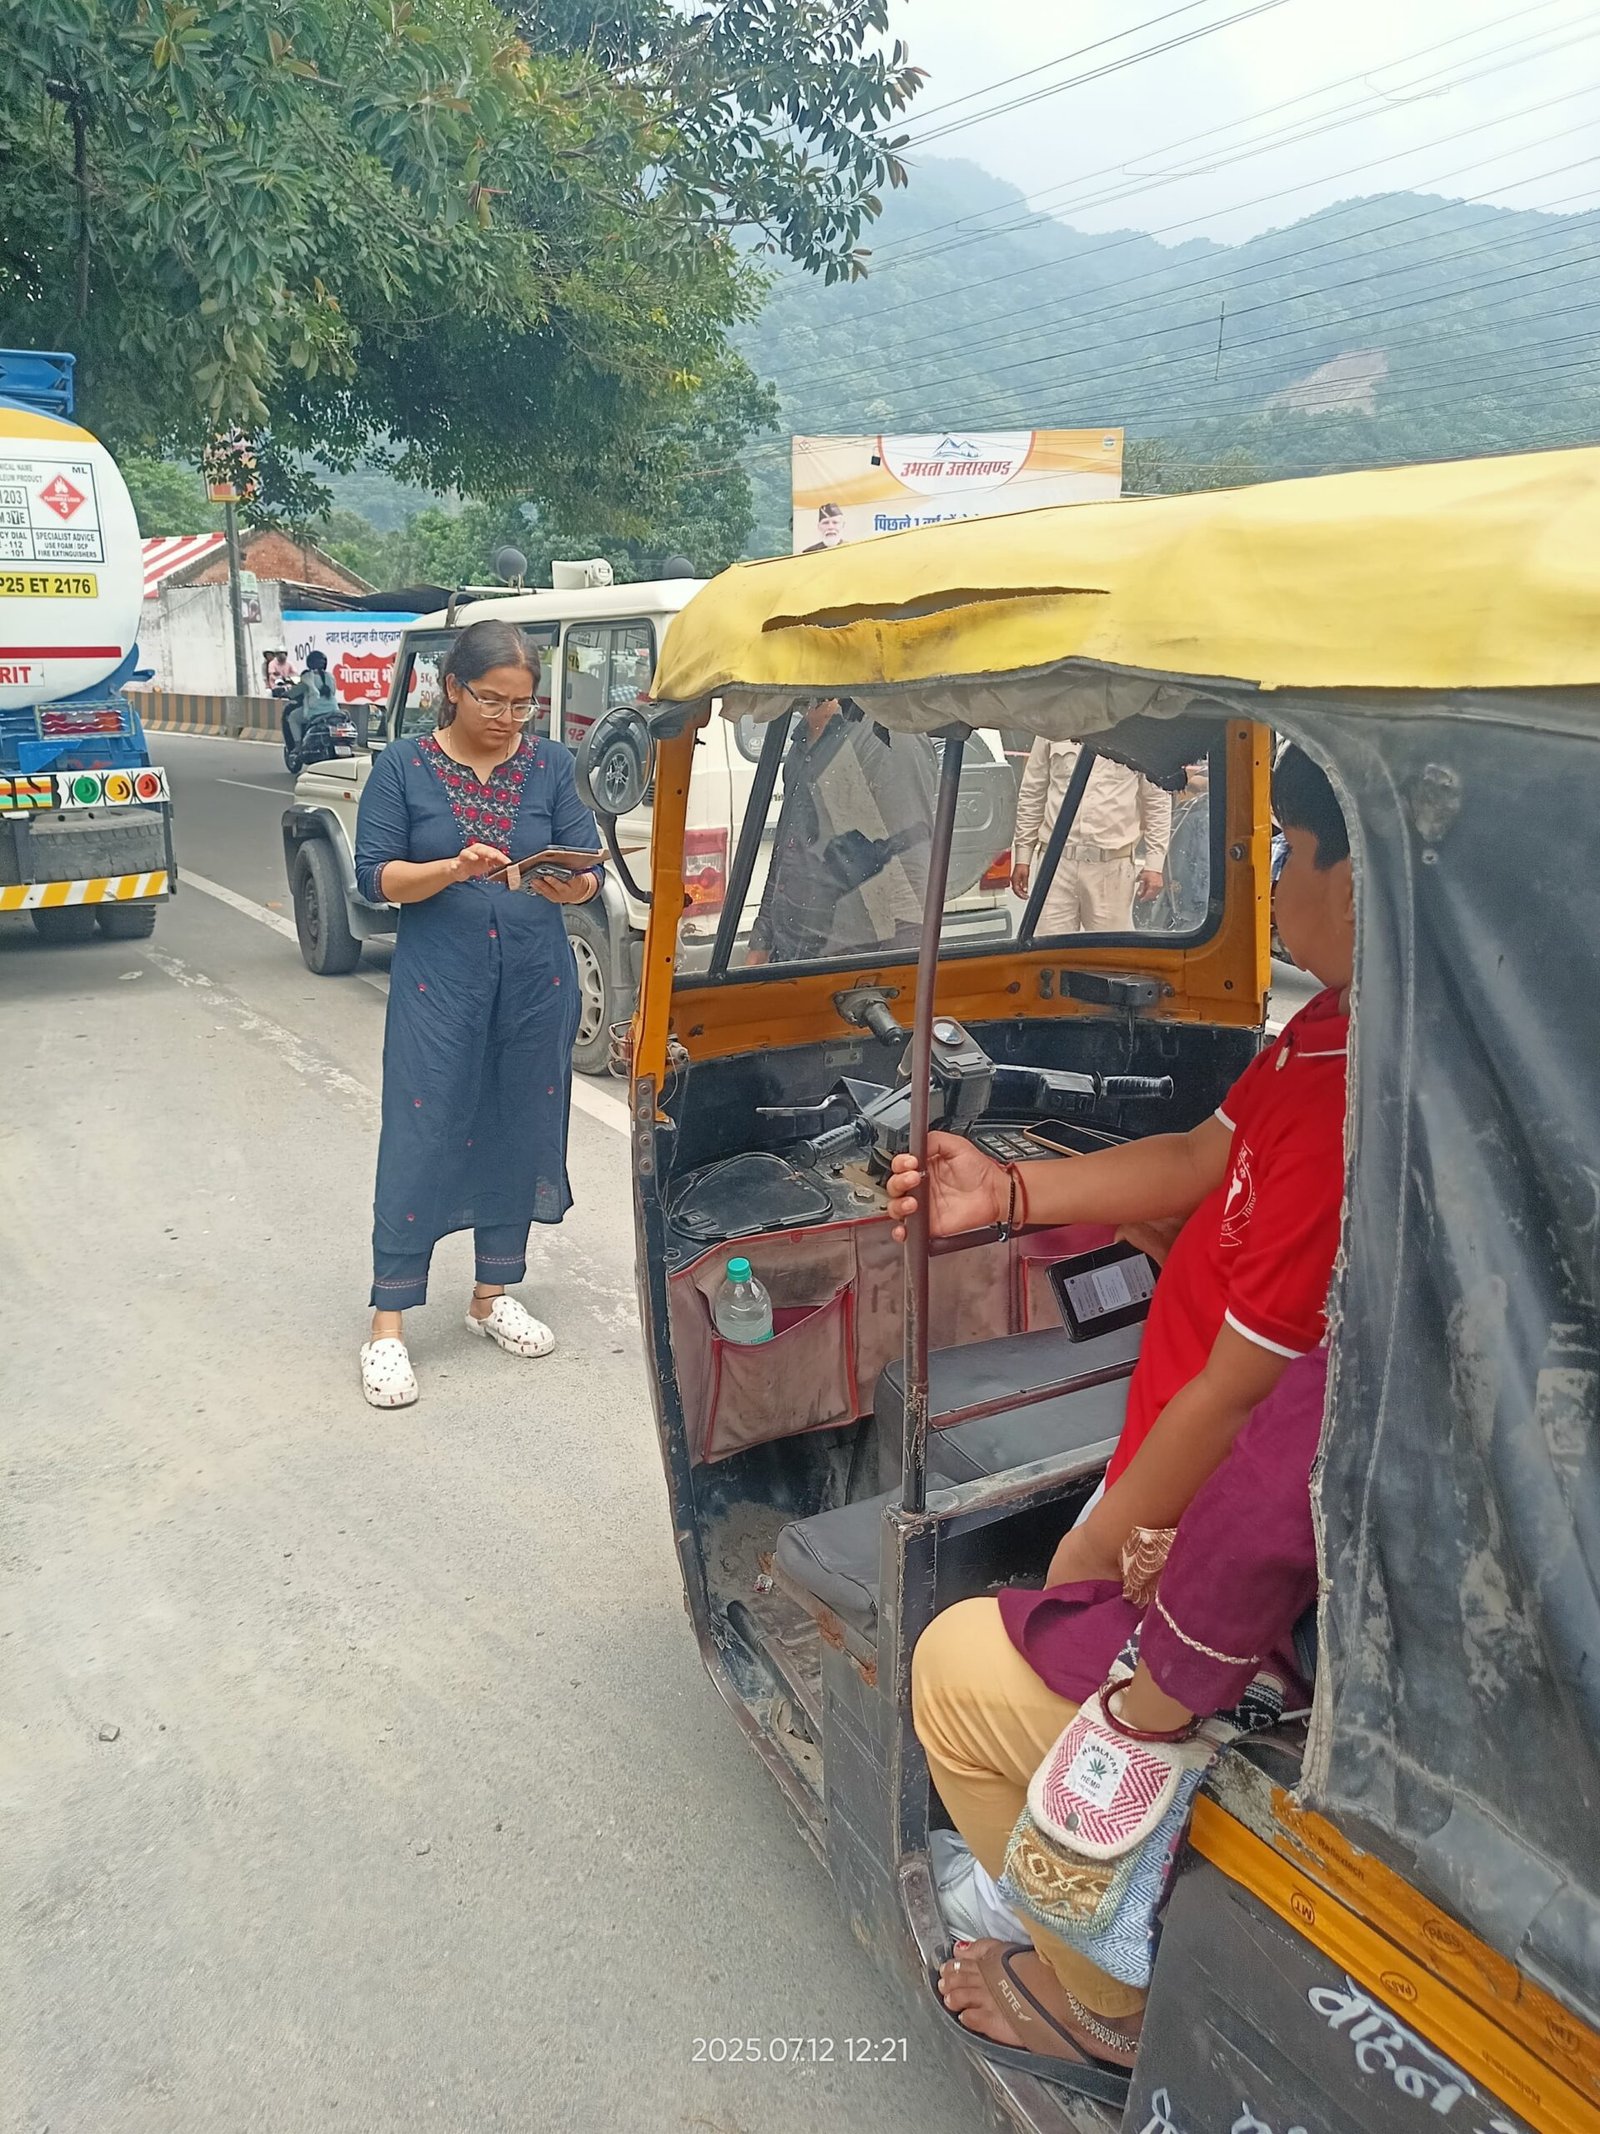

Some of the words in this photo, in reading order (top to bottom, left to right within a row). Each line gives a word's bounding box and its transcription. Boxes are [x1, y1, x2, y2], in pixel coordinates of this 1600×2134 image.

[900, 462, 944, 477] उभरता
[945, 460, 1013, 476] उत्तराखण्ड
[60, 503, 69, 513] 3
[874, 514, 911, 531] पिछले
[36, 532, 71, 541] SPECIALIST
[73, 533, 95, 542] ADVICE
[52, 550, 97, 558] EXTINGUISHERS
[29, 577, 49, 593] ET
[54, 578, 91, 594] 2176
[1082, 1745, 1119, 1775] HIMALAYAN
[1080, 1774, 1101, 1790] HEMP
[1428, 1927, 1462, 1949] PASS
[998, 1979, 1021, 2012] FLITE
[1307, 1974, 1477, 2115] वाहन
